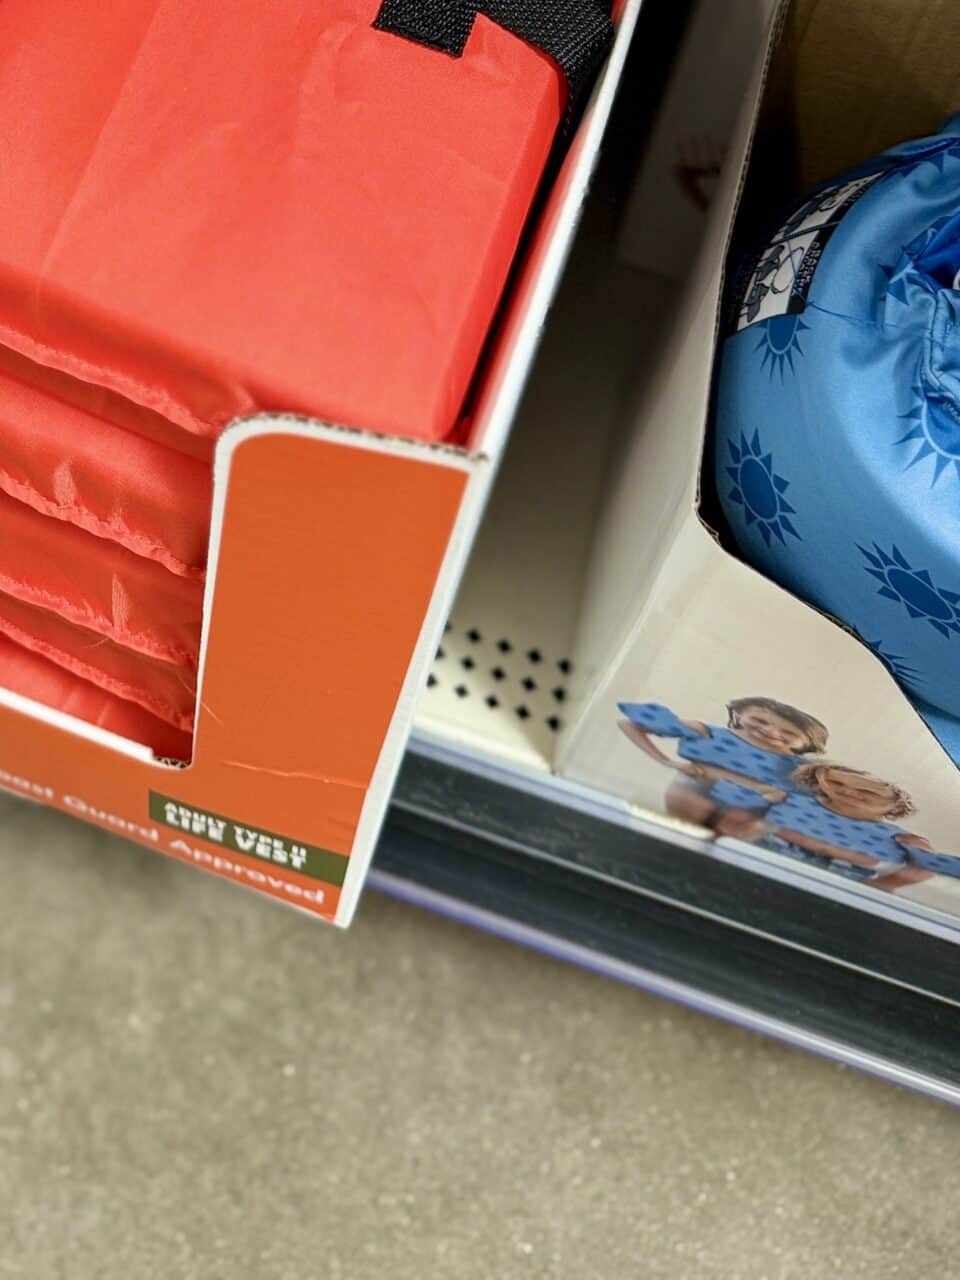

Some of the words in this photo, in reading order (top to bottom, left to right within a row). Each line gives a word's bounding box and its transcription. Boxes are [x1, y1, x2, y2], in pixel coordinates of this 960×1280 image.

[164, 801, 227, 830] ADULT
[165, 812, 224, 842] LIFE
[234, 831, 308, 870] VEST
[63, 794, 159, 842] Guard
[169, 839, 326, 904] Approved
